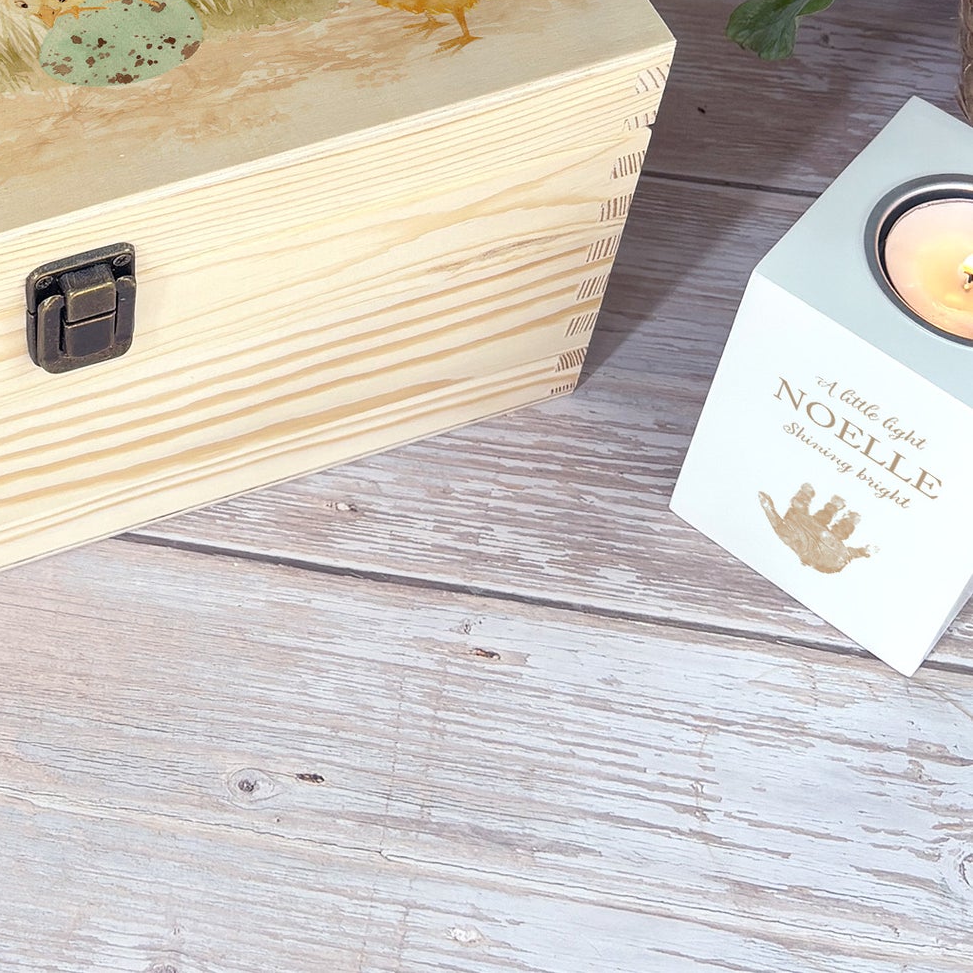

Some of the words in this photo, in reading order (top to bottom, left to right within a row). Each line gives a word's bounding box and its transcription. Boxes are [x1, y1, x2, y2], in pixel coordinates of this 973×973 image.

[773, 376, 942, 500] NOELLE
[815, 376, 839, 398] A
[840, 389, 880, 421] little
[883, 417, 927, 450] light
[783, 422, 854, 473] Shining
[856, 467, 911, 509] bright
